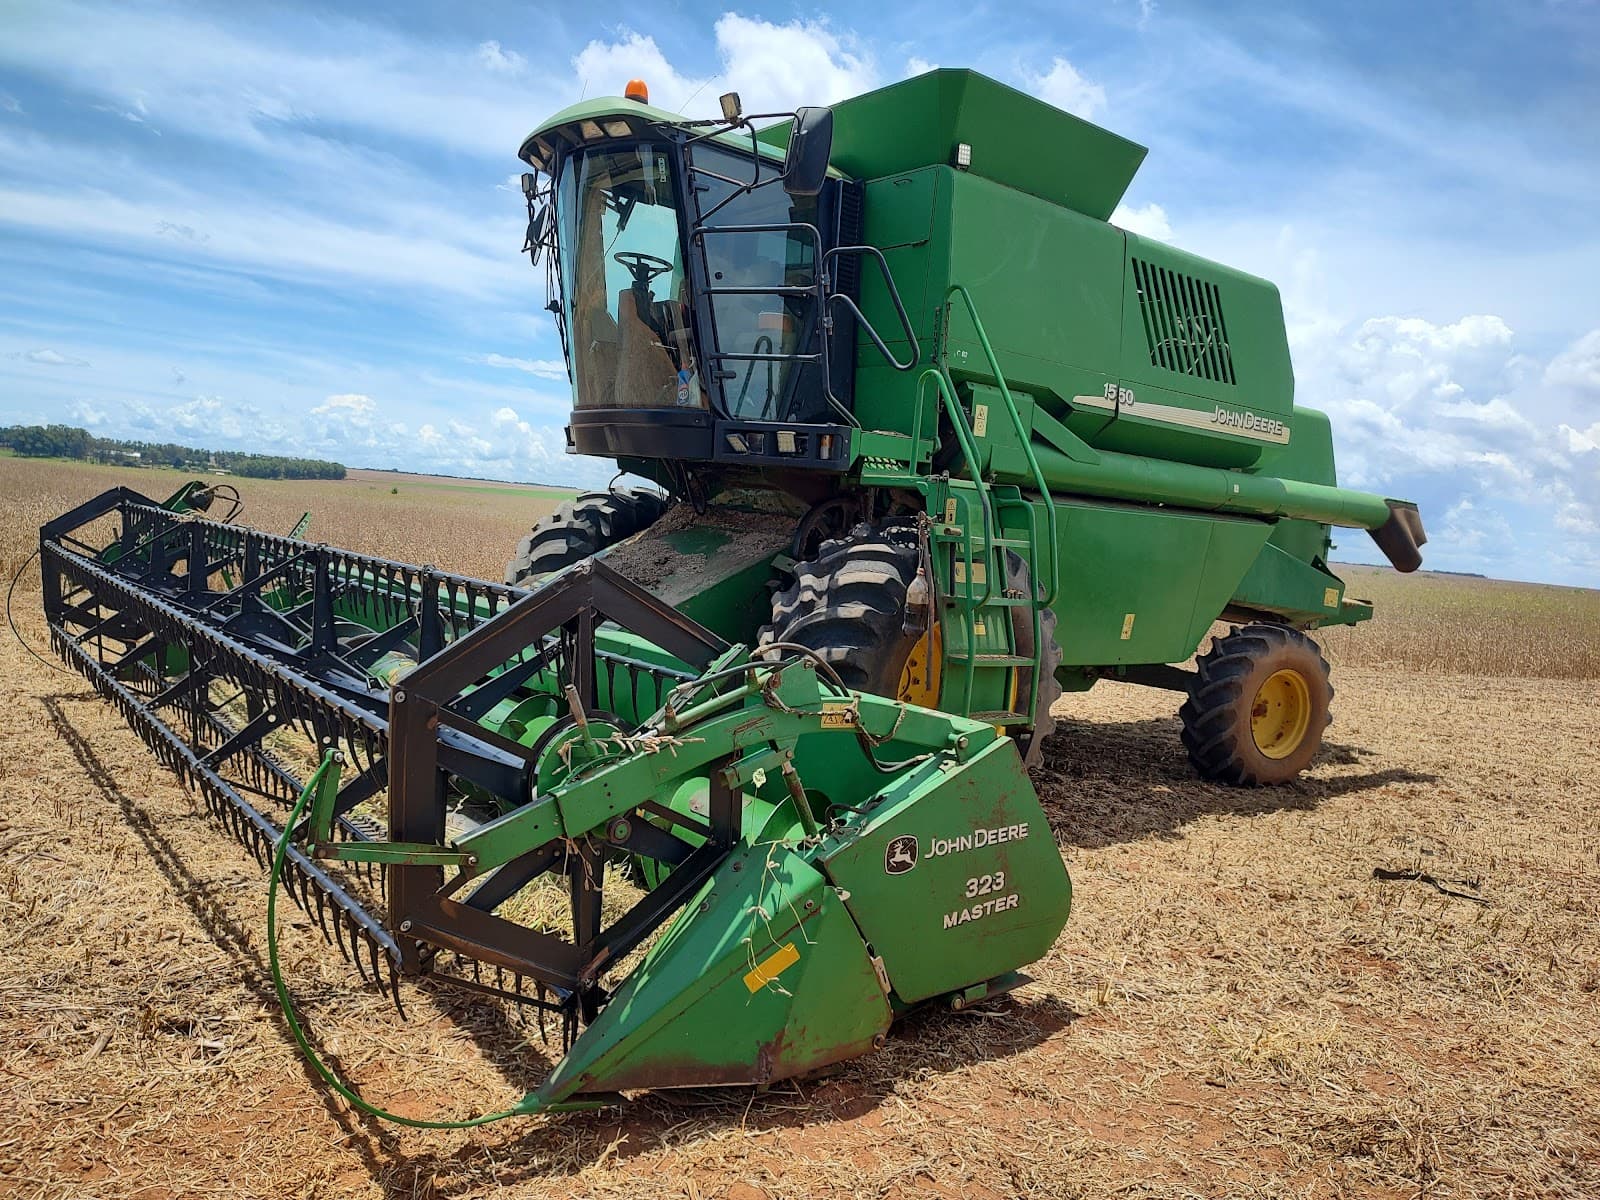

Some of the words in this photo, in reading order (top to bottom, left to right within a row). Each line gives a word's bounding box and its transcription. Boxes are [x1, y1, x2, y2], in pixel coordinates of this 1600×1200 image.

[1104, 382, 1134, 405] 1550
[1211, 405, 1244, 428] JOHN
[1244, 411, 1284, 435] DEERE
[924, 834, 972, 859] JOHN
[975, 823, 1029, 849] DEERE
[965, 871, 1006, 898] 323
[943, 894, 1019, 930] MASTER
